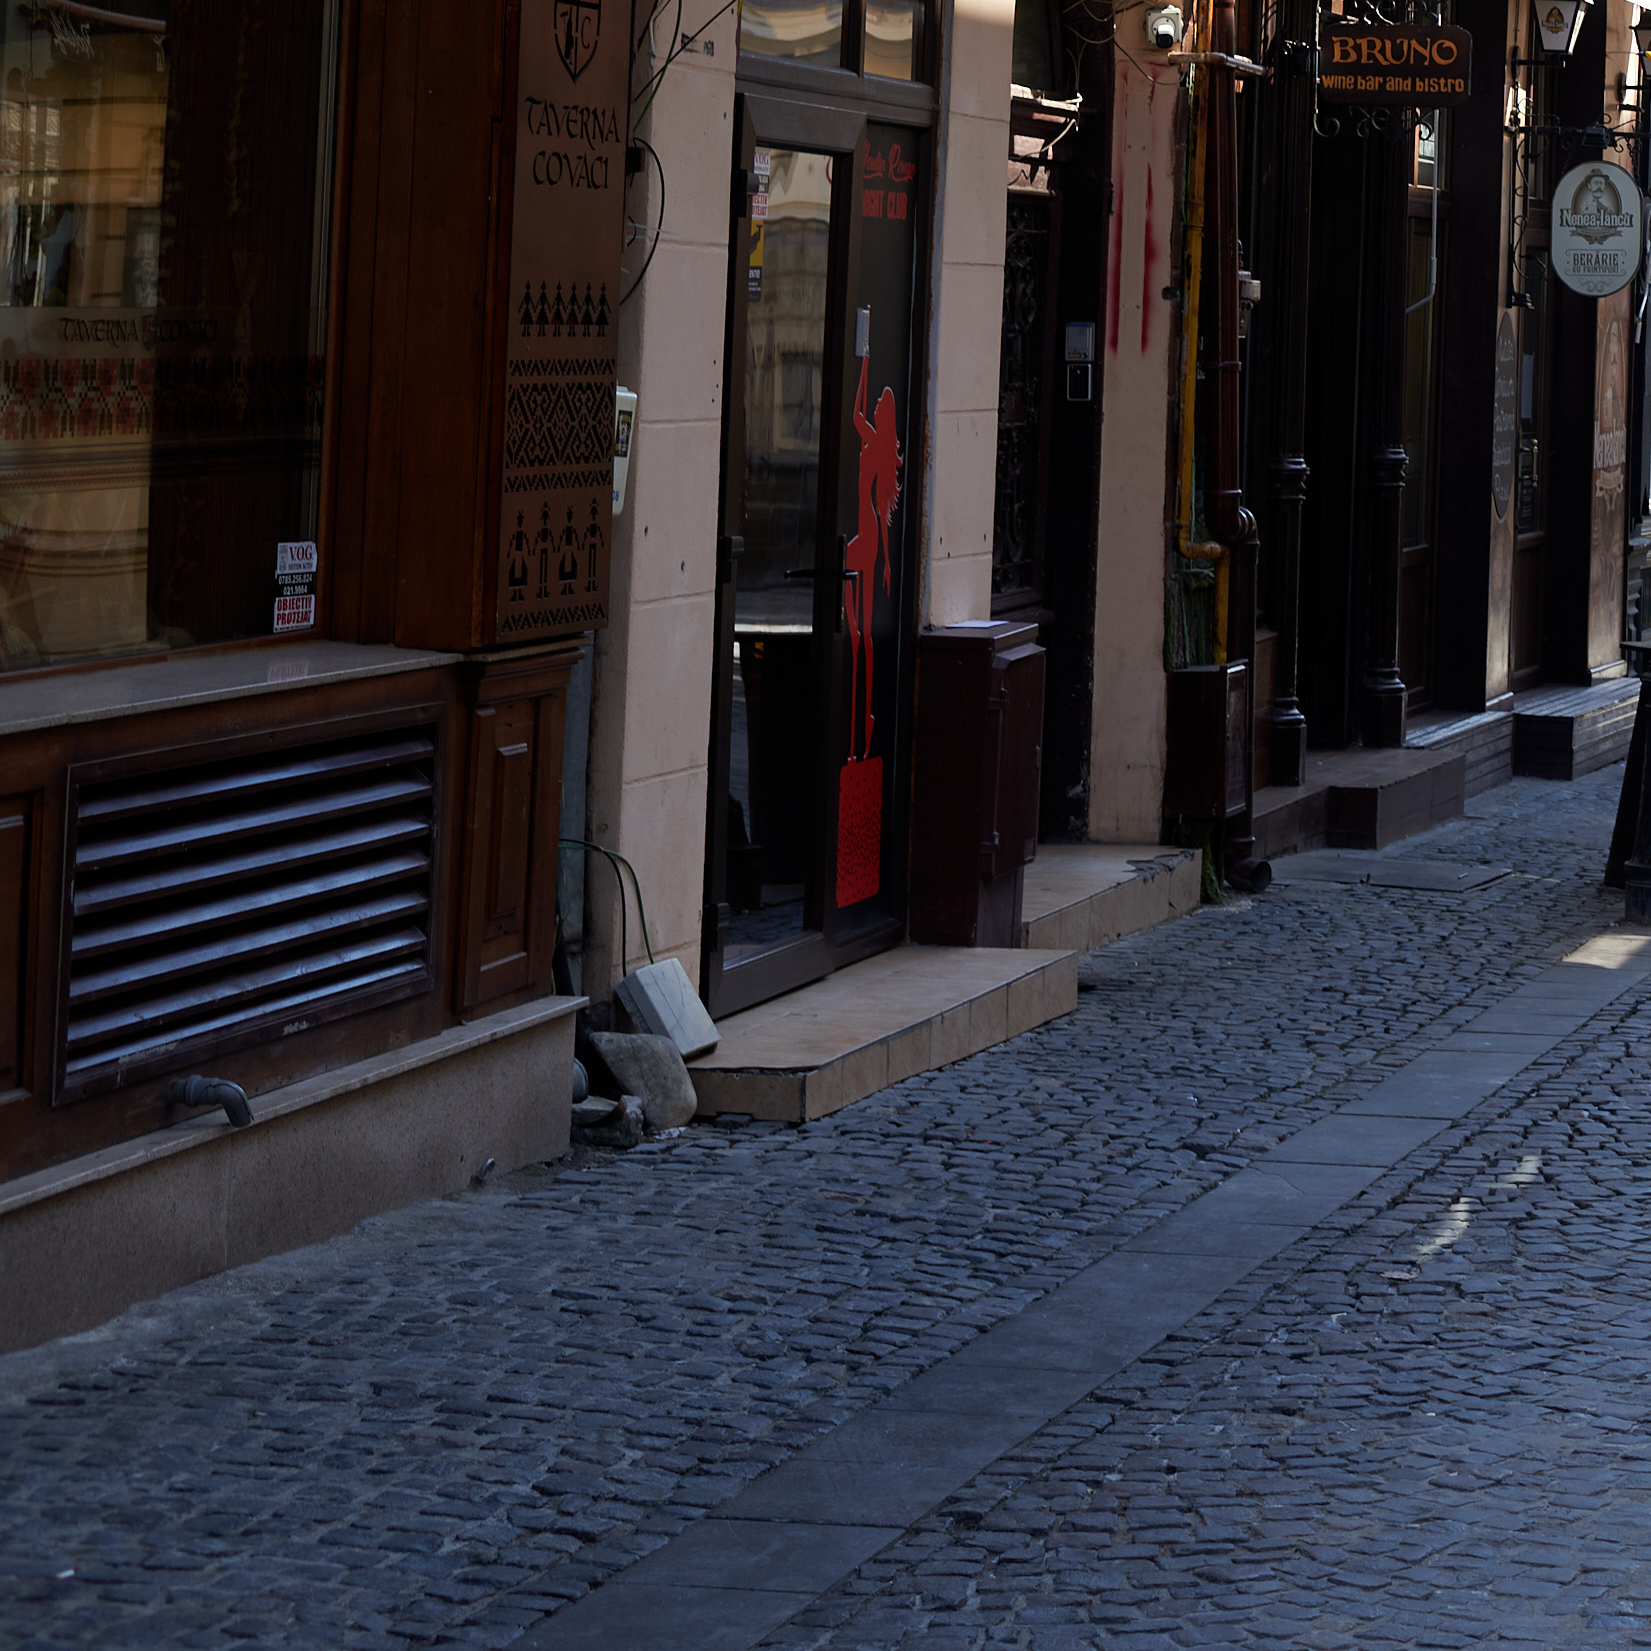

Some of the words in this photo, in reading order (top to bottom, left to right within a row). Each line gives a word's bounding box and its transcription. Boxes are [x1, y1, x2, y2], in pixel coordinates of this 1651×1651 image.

[1332, 36, 1458, 66] BRUNO
[1322, 76, 1355, 92] wine
[1357, 74, 1383, 92] bar
[1386, 74, 1412, 92] and
[1416, 76, 1464, 93] bistro
[526, 97, 620, 150] TAVERNA
[533, 152, 609, 190] COVACI
[1560, 209, 1597, 227] Nenea
[58, 316, 139, 348] TAVERNA
[159, 318, 218, 342] COVACI
[277, 596, 312, 612] OBIECTIV
[276, 610, 312, 626] PROTEJAT
